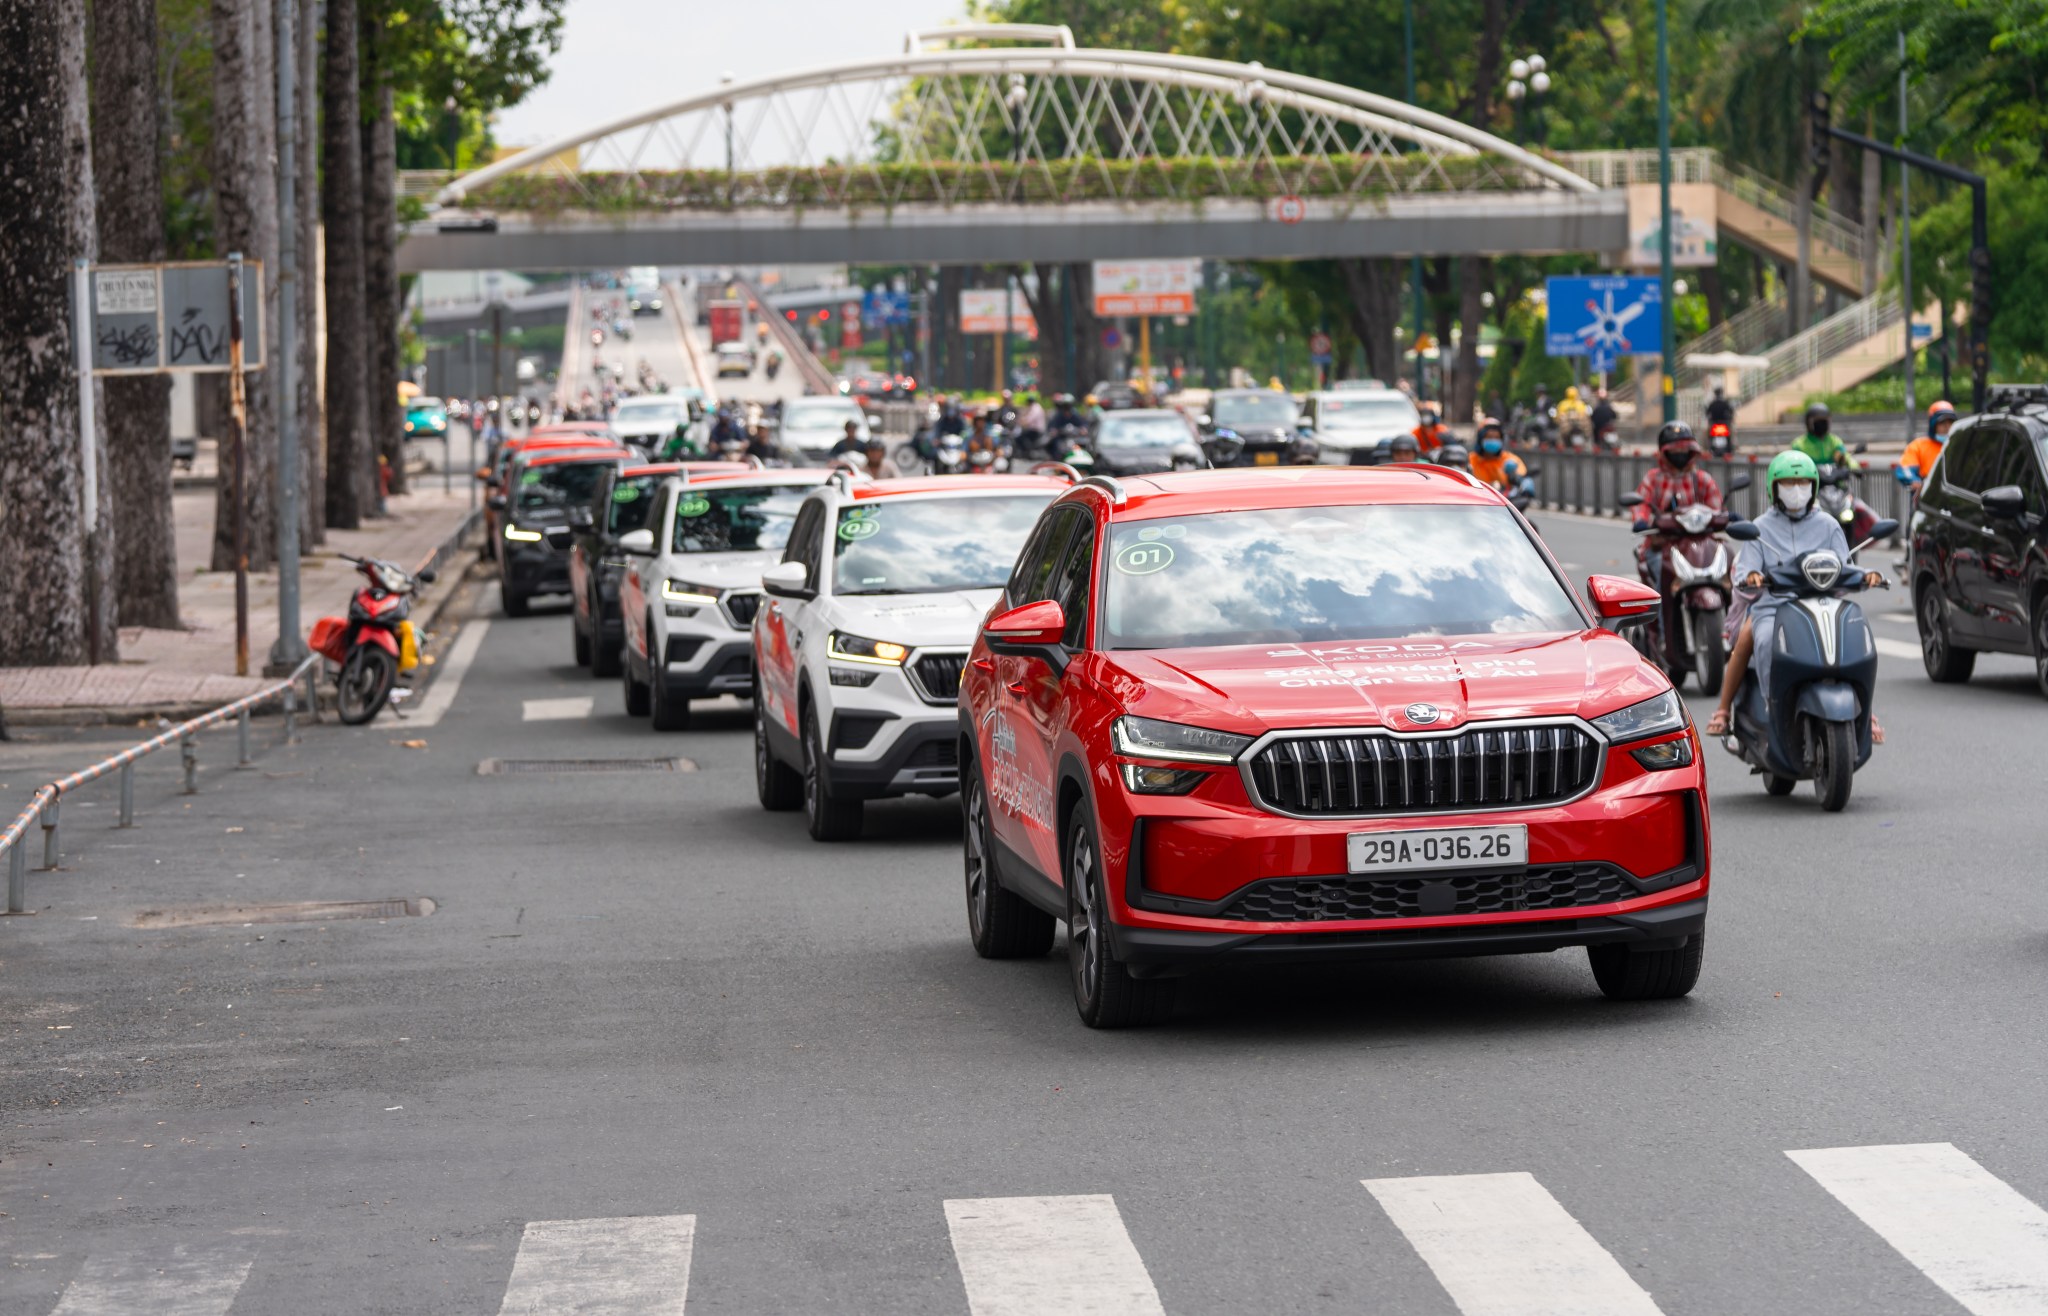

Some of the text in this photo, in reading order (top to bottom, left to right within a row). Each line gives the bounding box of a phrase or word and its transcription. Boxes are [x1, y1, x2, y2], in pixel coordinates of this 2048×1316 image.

[845, 522, 873, 535] 03
[1129, 548, 1160, 566] 01
[1364, 834, 1511, 864] 29A-036.26
